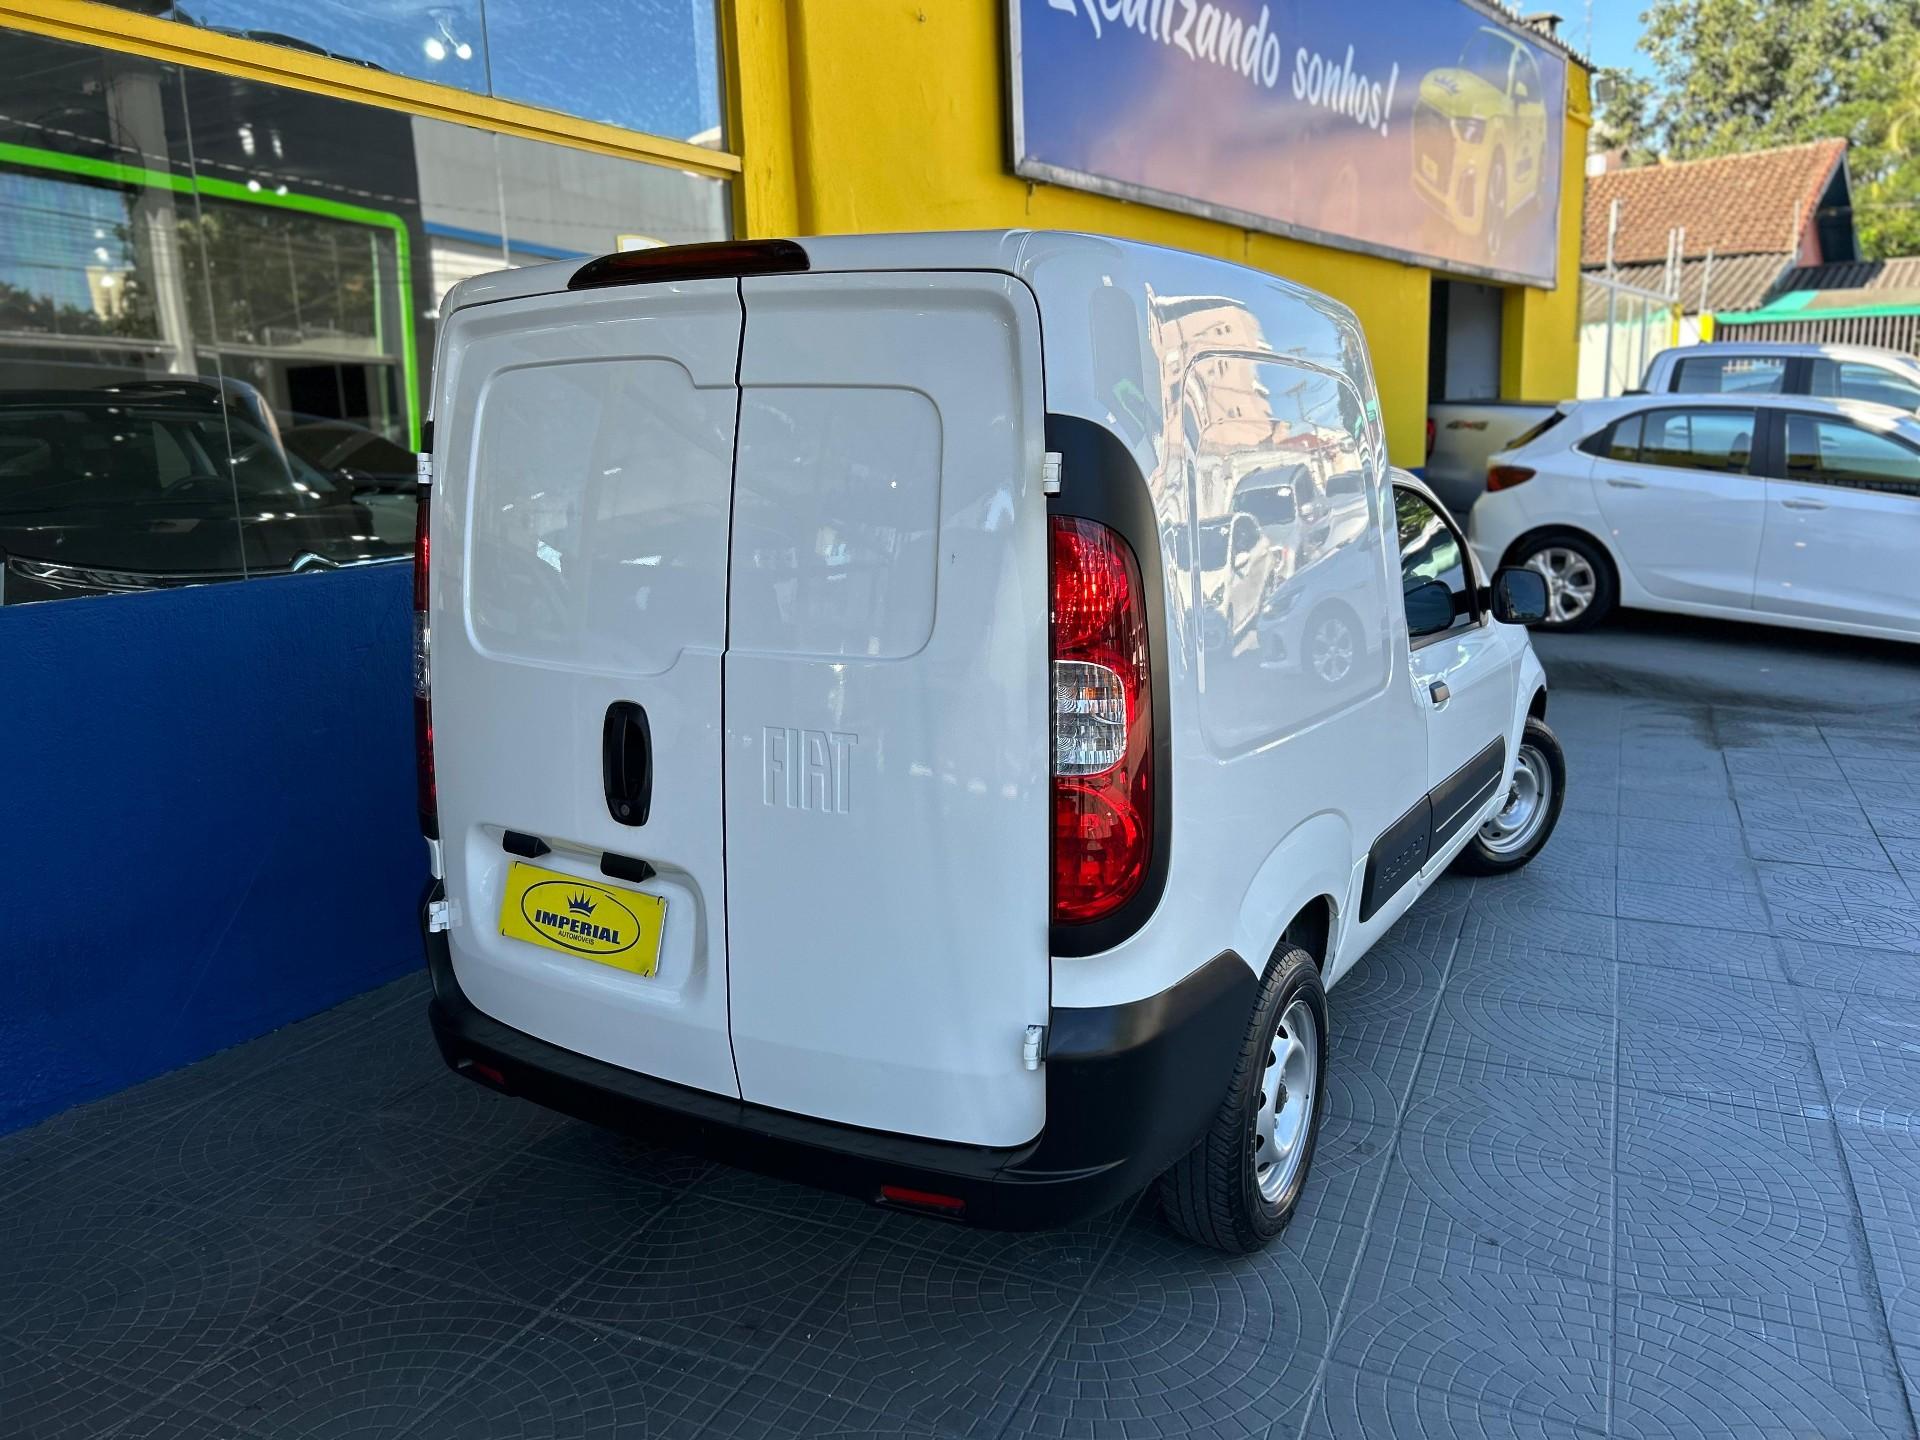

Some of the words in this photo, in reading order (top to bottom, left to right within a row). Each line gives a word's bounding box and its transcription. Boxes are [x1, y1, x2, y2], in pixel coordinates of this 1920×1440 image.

[1292, 44, 1399, 137] sonhos!
[762, 726, 858, 814] FIAT
[535, 909, 620, 944] IMPERIAL
